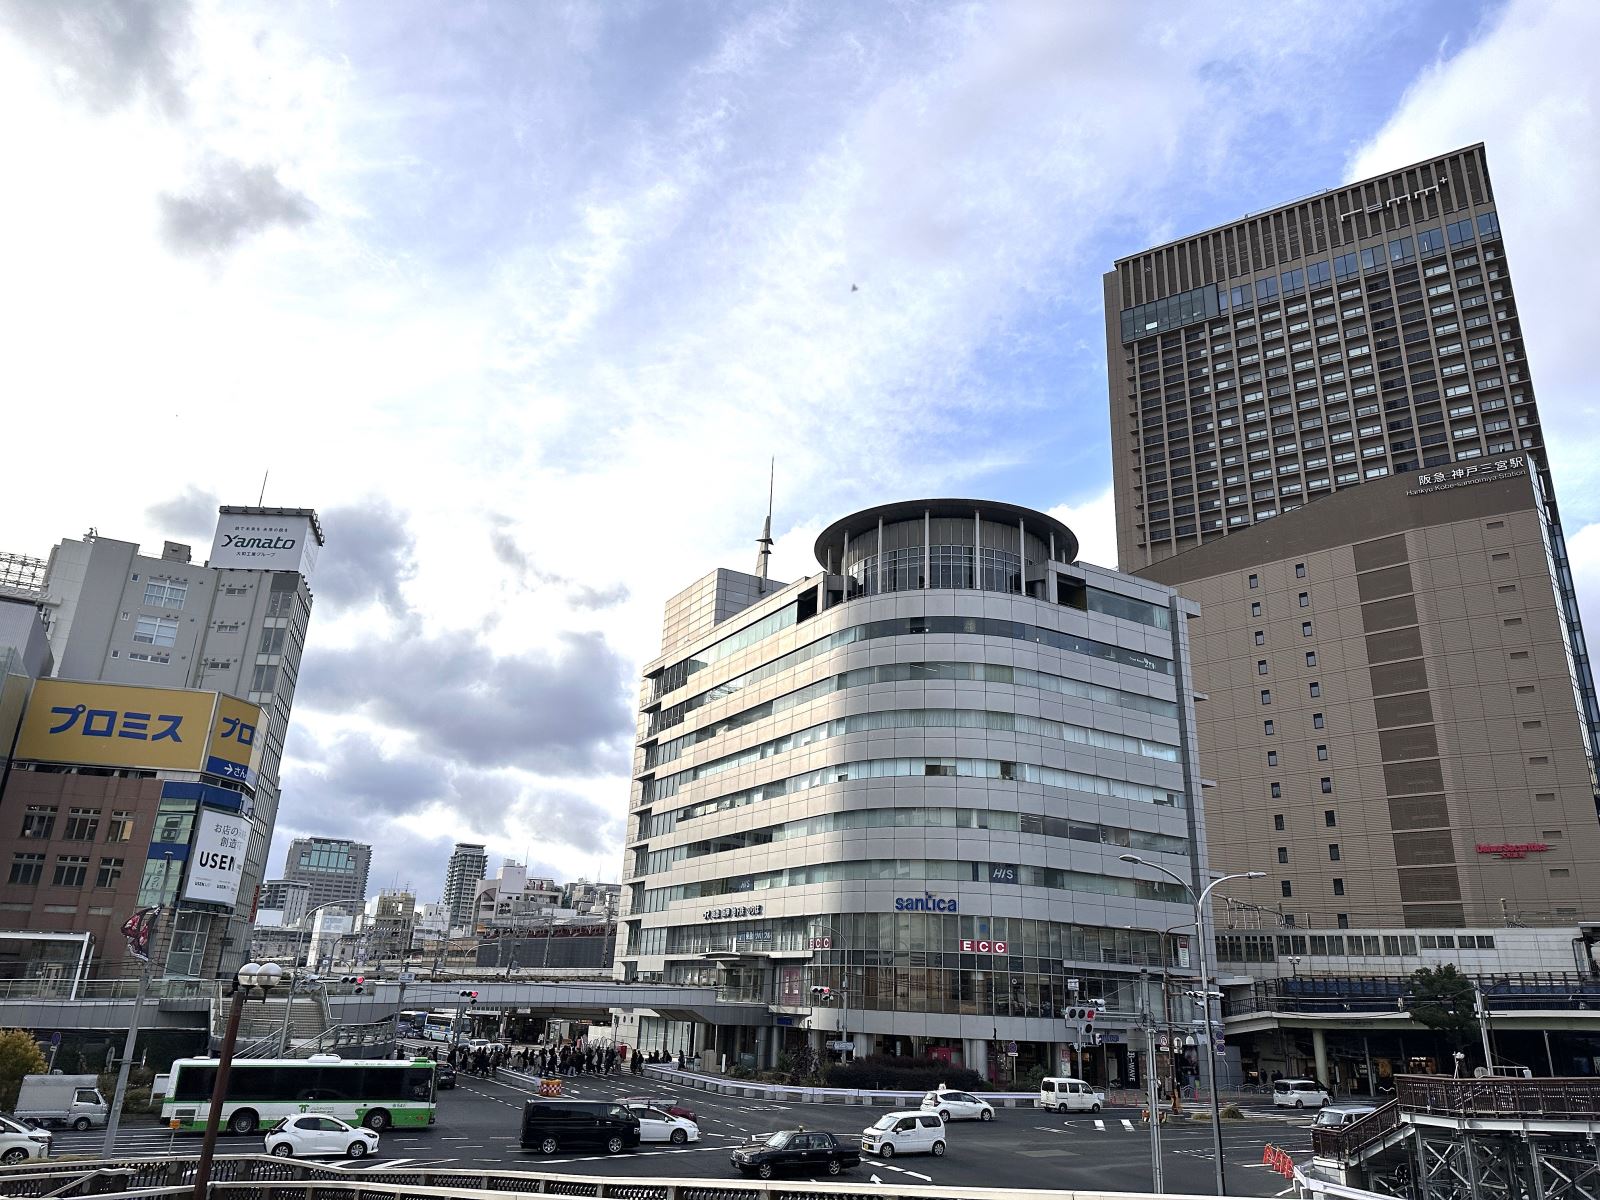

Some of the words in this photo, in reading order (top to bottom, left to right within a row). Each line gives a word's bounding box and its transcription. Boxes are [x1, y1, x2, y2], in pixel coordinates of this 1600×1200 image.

[1418, 471, 1446, 486] 阪急
[1451, 456, 1525, 480] 神戸三宮駅
[1406, 485, 1434, 497] Hankyu
[1499, 468, 1527, 480] Station
[221, 534, 296, 550] Yamato
[49, 704, 184, 742] プロミス
[992, 868, 1014, 880] HIS
[895, 891, 958, 913] santica
[963, 940, 1005, 953] ECC
